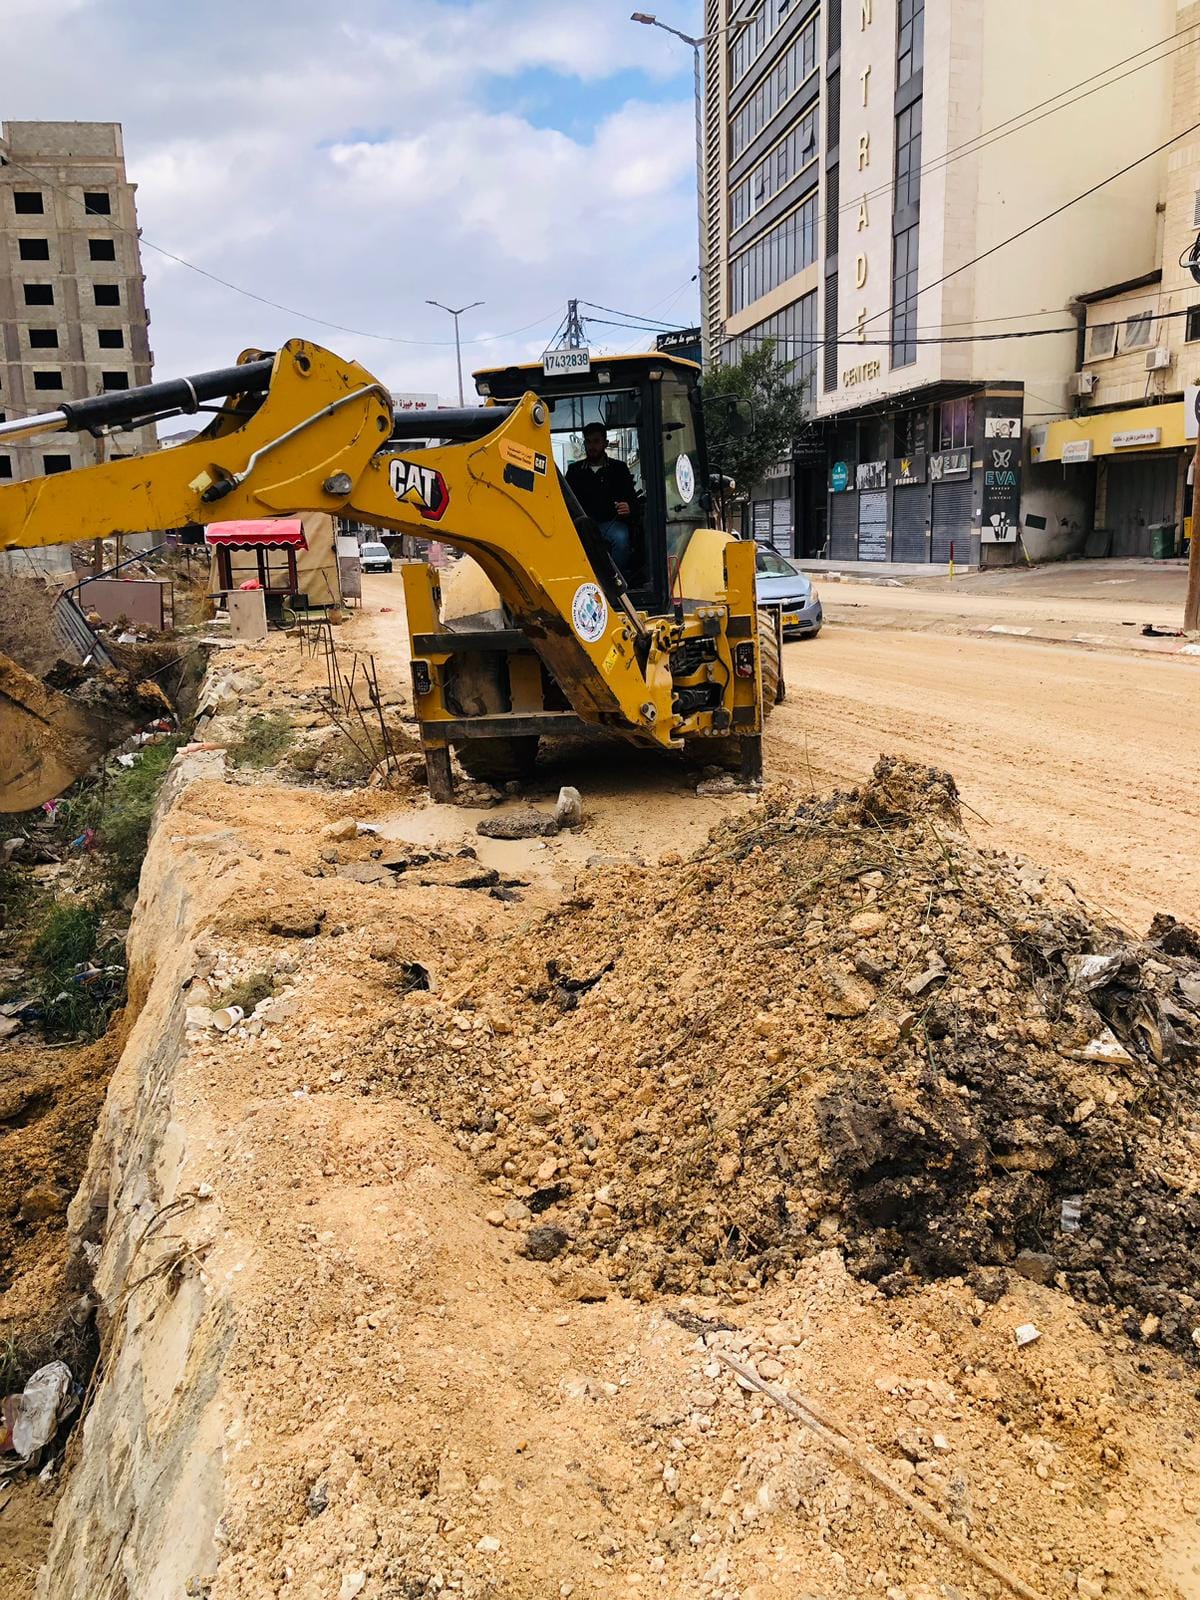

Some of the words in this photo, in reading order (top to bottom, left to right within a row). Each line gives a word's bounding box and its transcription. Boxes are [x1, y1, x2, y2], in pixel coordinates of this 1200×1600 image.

[842, 360, 881, 388] CENTER
[534, 457, 546, 470] CAT
[390, 459, 436, 508] CAT
[984, 470, 1017, 486] EVA
